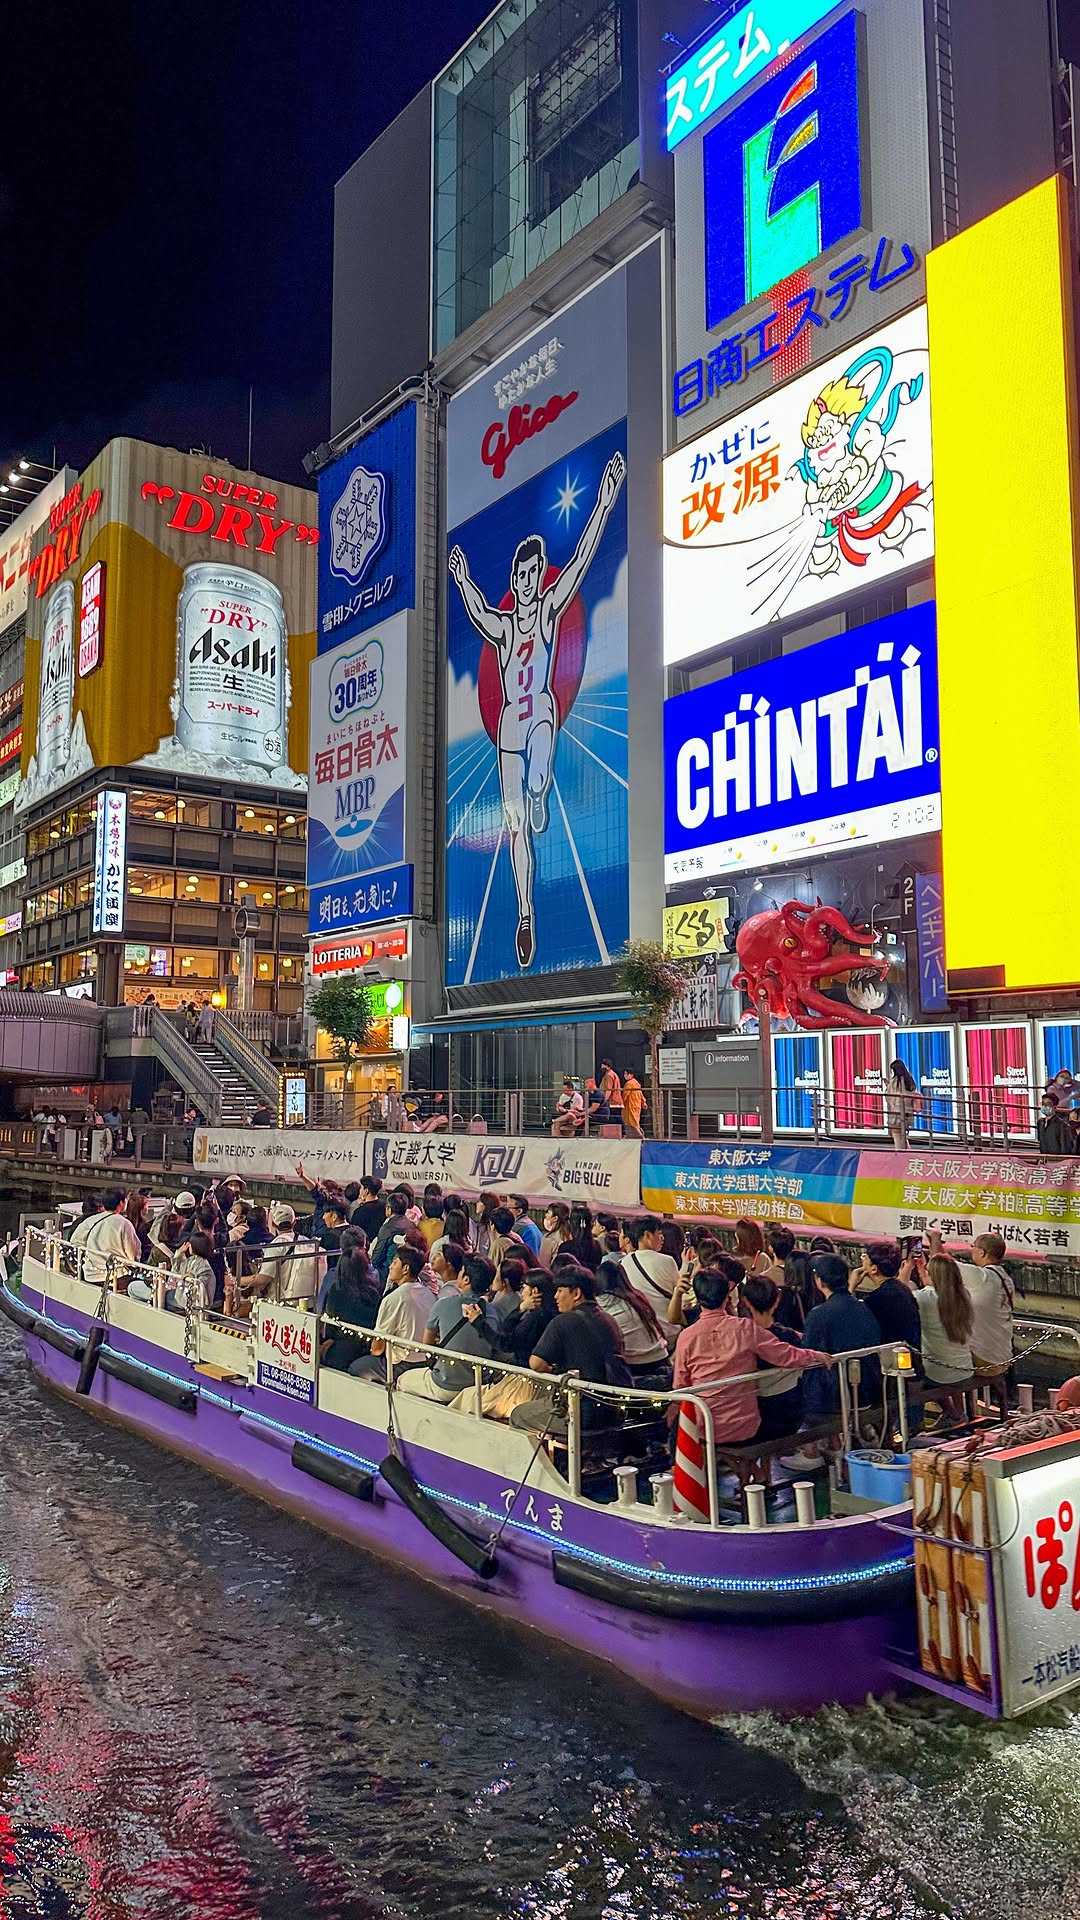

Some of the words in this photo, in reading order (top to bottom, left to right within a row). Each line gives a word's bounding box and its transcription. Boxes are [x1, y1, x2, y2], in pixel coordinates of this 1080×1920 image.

[673, 236, 915, 417] 日商エステム
[481, 390, 579, 479] Glico
[689, 420, 772, 483] かぜに
[49, 482, 82, 535] SUPER
[201, 474, 279, 511] SUPER
[681, 443, 781, 541] 改源
[219, 600, 251, 614] SUPER
[322, 575, 394, 633] 雪印メグミルク
[81, 609, 99, 644] 1889
[80, 636, 97, 672] OSAKA
[189, 627, 276, 679] Asahi
[223, 674, 245, 692] 生
[335, 669, 377, 714] 30周年
[516, 634, 536, 722] グリコ
[208, 701, 260, 718] スーパードライ
[326, 710, 386, 745] まいにちほねぶと
[315, 724, 399, 785] 毎日骨太
[335, 775, 376, 822] MBP
[108, 813, 121, 859] 本場の味
[106, 863, 121, 927] かに道楽
[674, 908, 716, 948] くくる
[314, 945, 363, 966] LOTTERIA
[715, 1053, 750, 1064] information
[865, 1068, 881, 1078] Street
[932, 1067, 949, 1077] Street
[1007, 1066, 1026, 1077] Street
[390, 1139, 457, 1167] 近畿大学
[574, 1160, 602, 1171] KINDAI
[708, 1149, 772, 1167] 東大阪大学
[563, 1169, 582, 1186] BIG
[583, 1171, 613, 1188] BLUE
[674, 1171, 804, 1197] 東大阪大学短期大学部
[675, 1195, 805, 1221] 東大阪大学附属幼稚園
[899, 1214, 975, 1236] 夢輝く学園
[988, 1222, 1070, 1248] はばたく若者
[262, 1318, 311, 1363] ぽんぽん船
[261, 1364, 270, 1376] TEL
[500, 1488, 564, 1531] てんま
[1023, 1500, 1080, 1612] ぽ
